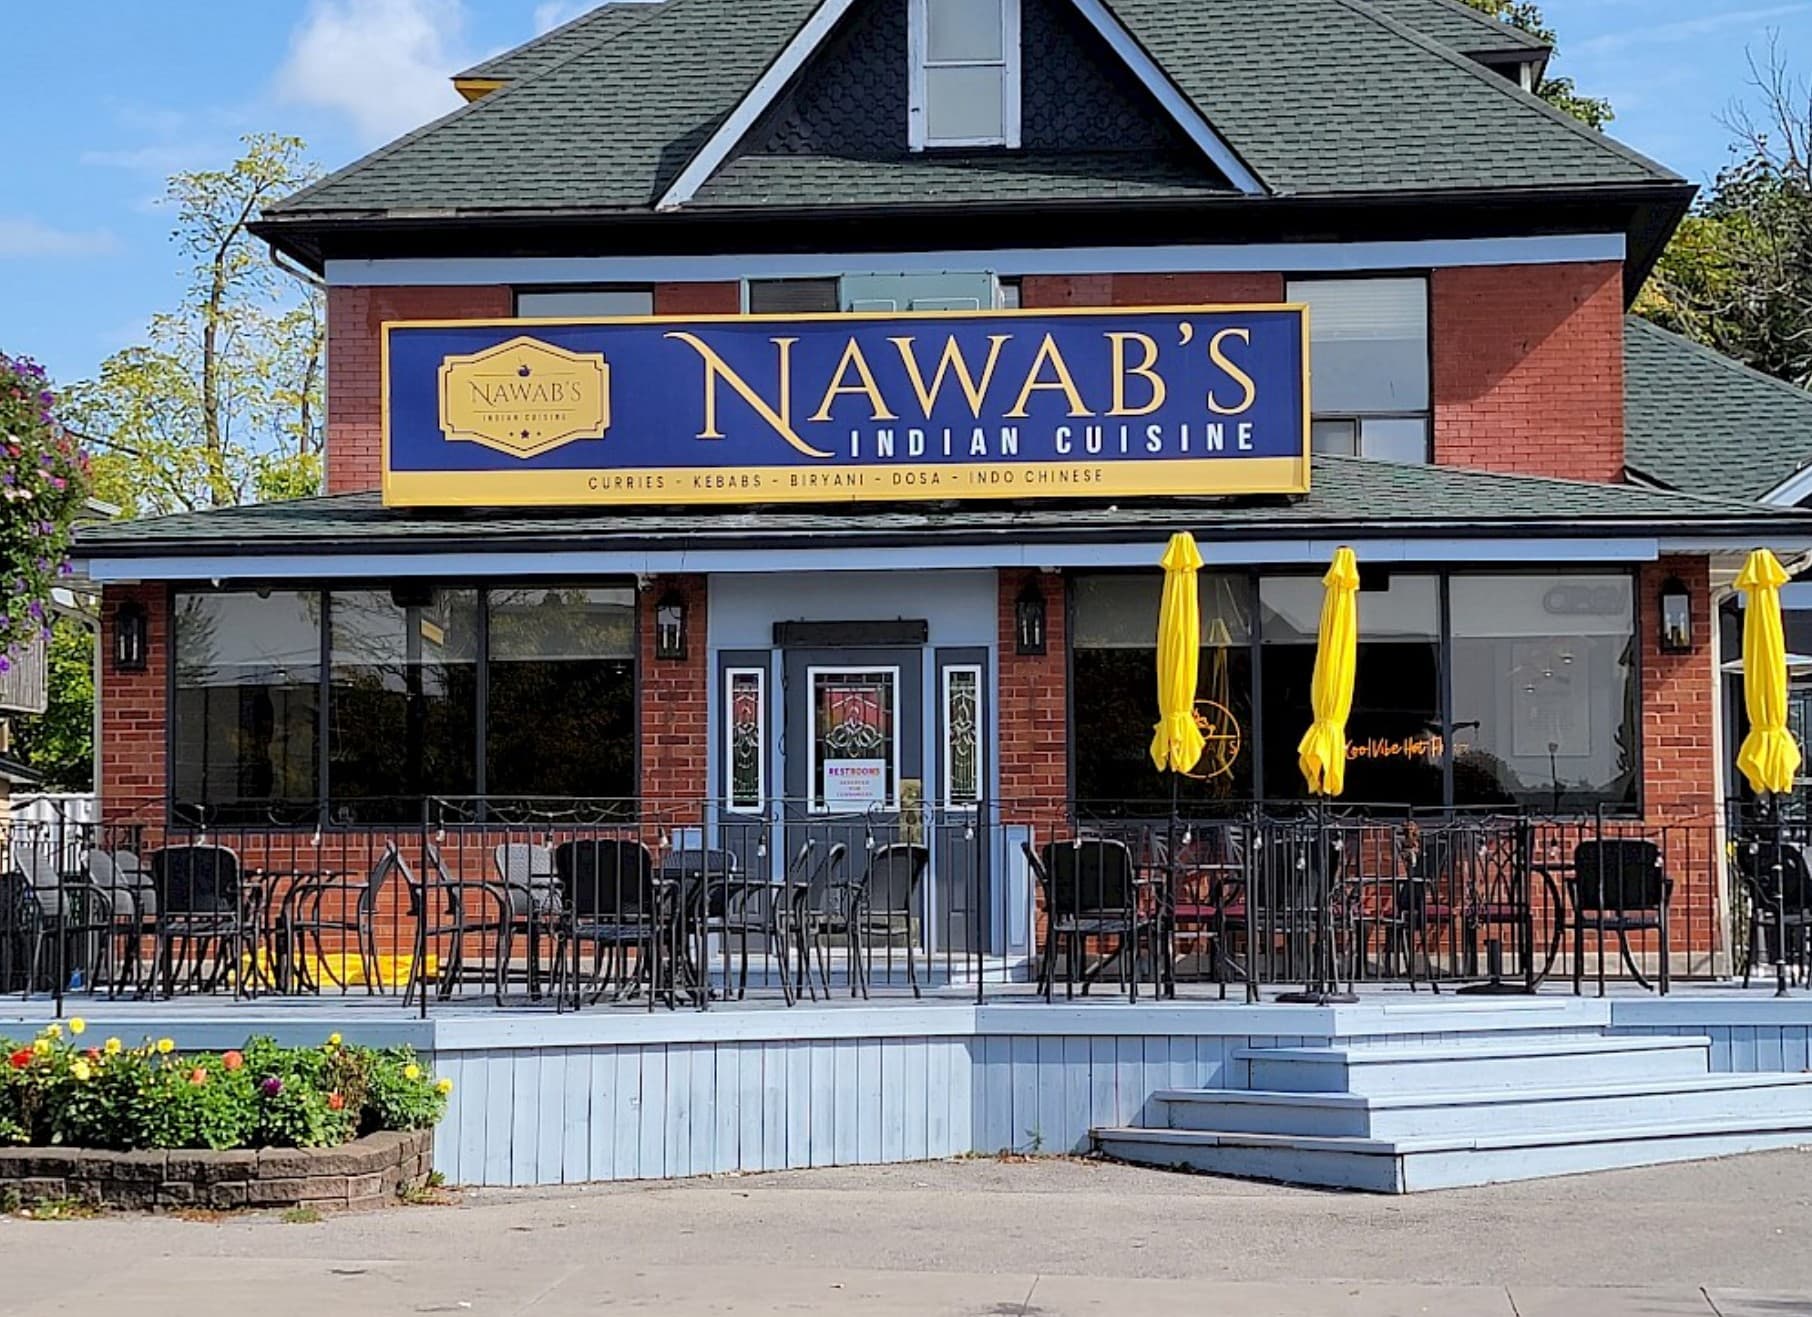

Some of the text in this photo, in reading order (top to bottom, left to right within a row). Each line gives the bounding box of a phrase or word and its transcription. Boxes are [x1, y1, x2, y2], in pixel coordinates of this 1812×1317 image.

[467, 380, 582, 408] NAWAB'S
[663, 321, 1257, 458] NAWAB'S
[851, 422, 1254, 457] INDIAN CUISINE
[588, 476, 664, 490] CURRIES
[693, 474, 761, 488] KEBABS
[790, 473, 864, 487] BIRYANI
[892, 471, 941, 485] DOSA
[969, 470, 1015, 484] INDO
[1025, 468, 1102, 483] CHINESE
[829, 767, 880, 776] RESTROOMS
